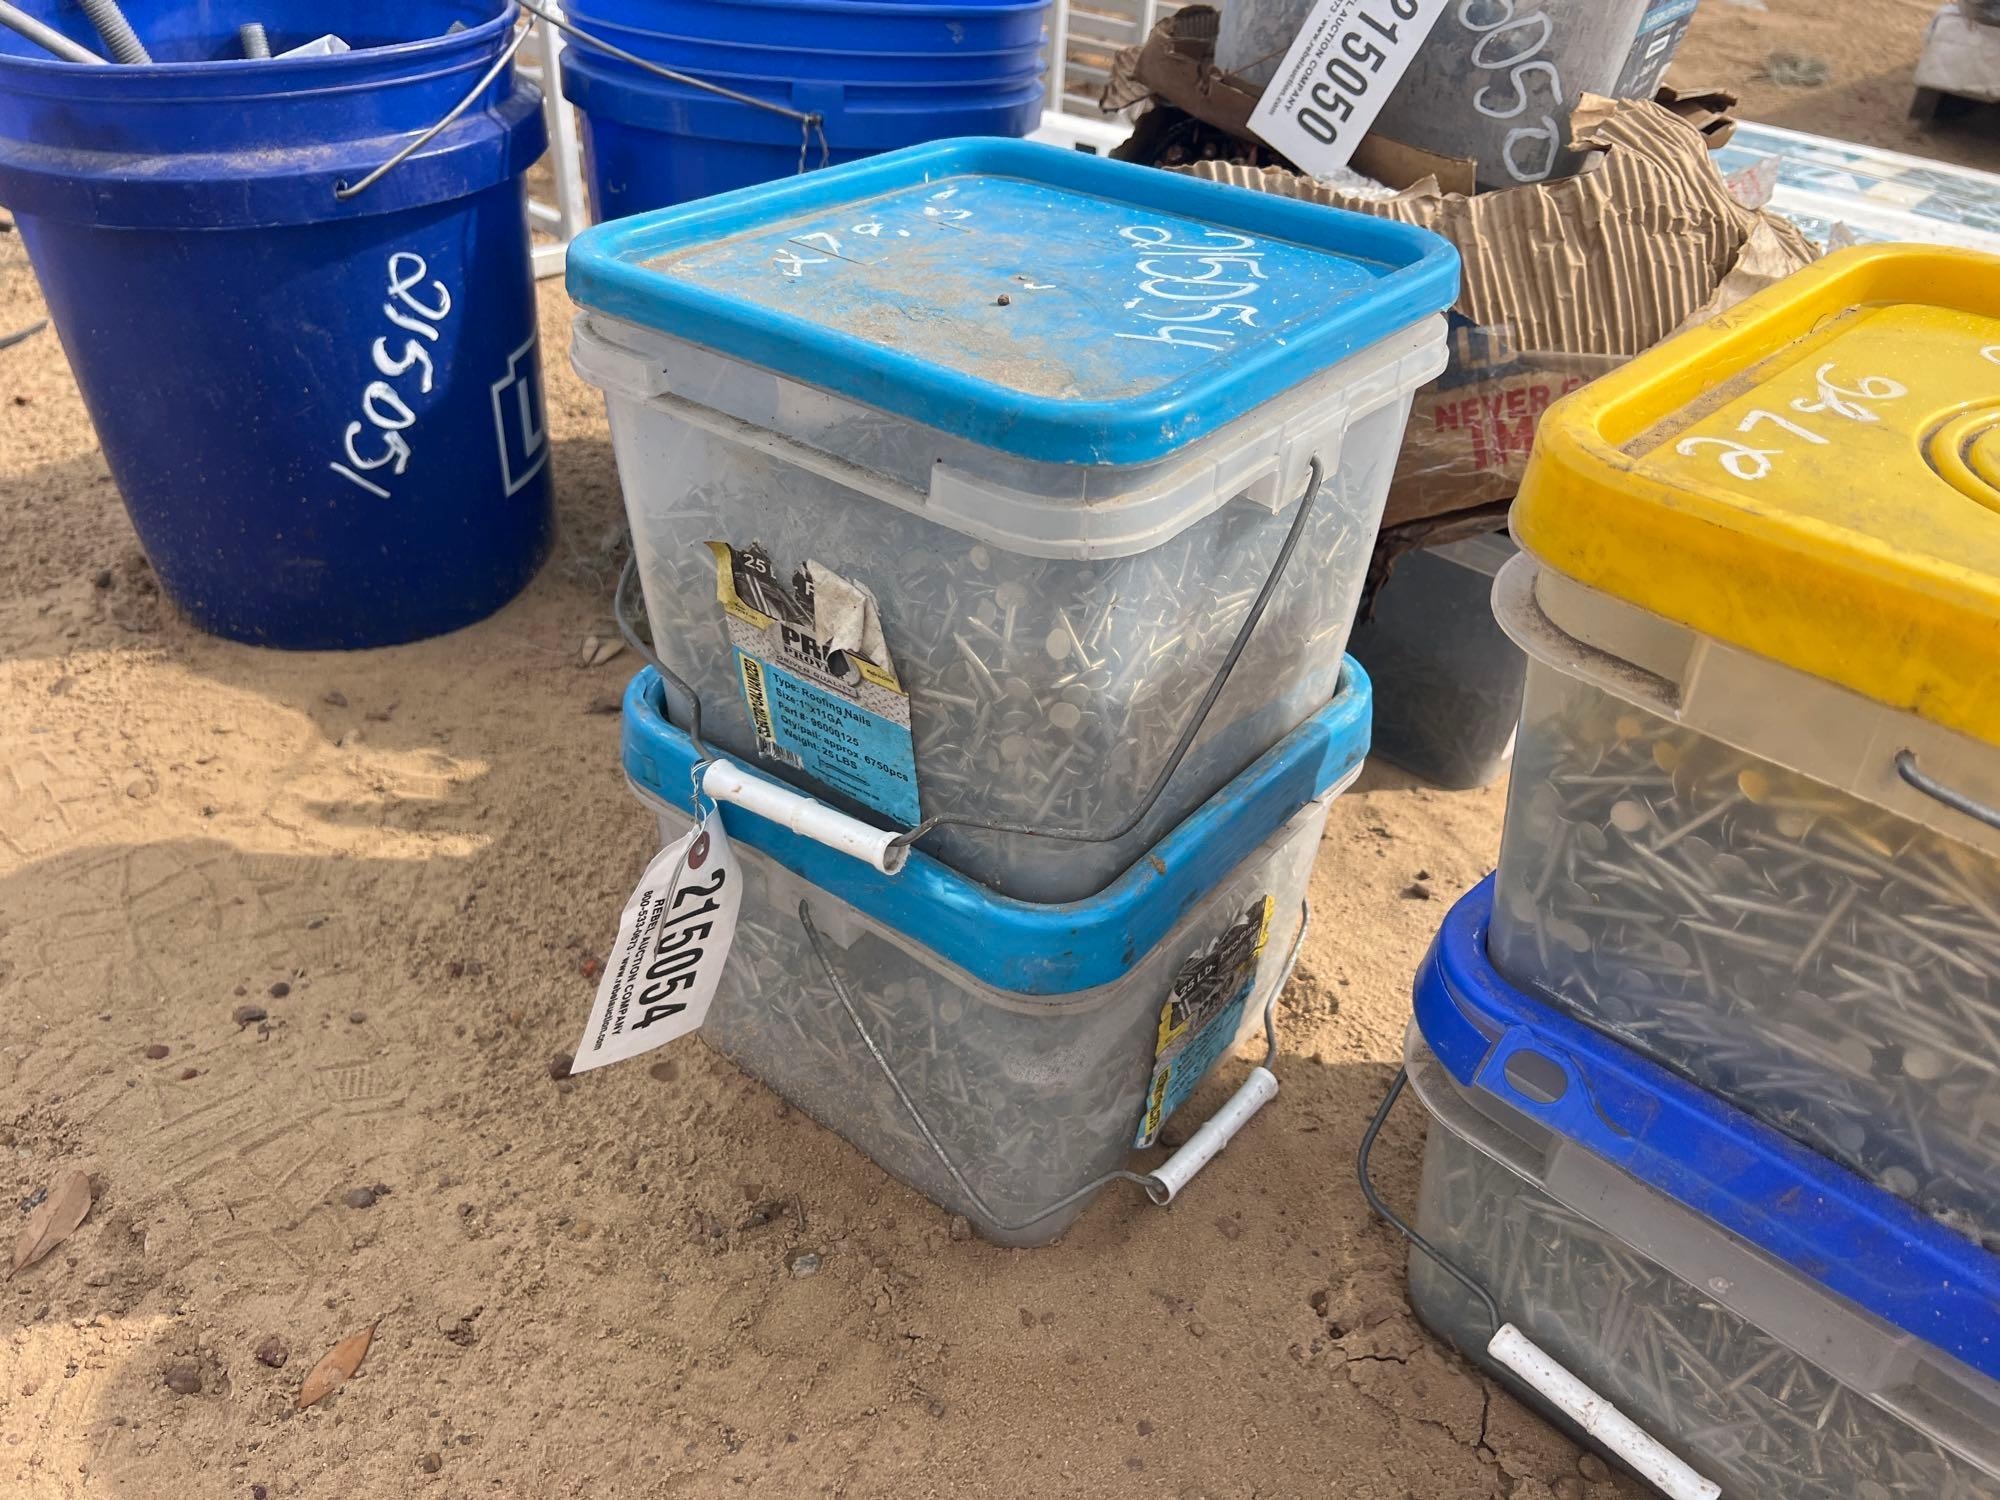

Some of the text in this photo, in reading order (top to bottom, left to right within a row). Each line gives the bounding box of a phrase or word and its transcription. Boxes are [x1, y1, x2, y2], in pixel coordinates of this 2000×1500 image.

[1315, 8, 1350, 59] AUCTION
[1285, 59, 1318, 113] COMPANY
[330, 252, 453, 499] 215051
[1434, 385, 1551, 433] NEVER
[773, 672, 871, 727] Type: Roofing Nails
[836, 754, 858, 770] LBS
[611, 898, 666, 1035] REBEL AUCTION COMPANY
[632, 868, 726, 1030] 215054
